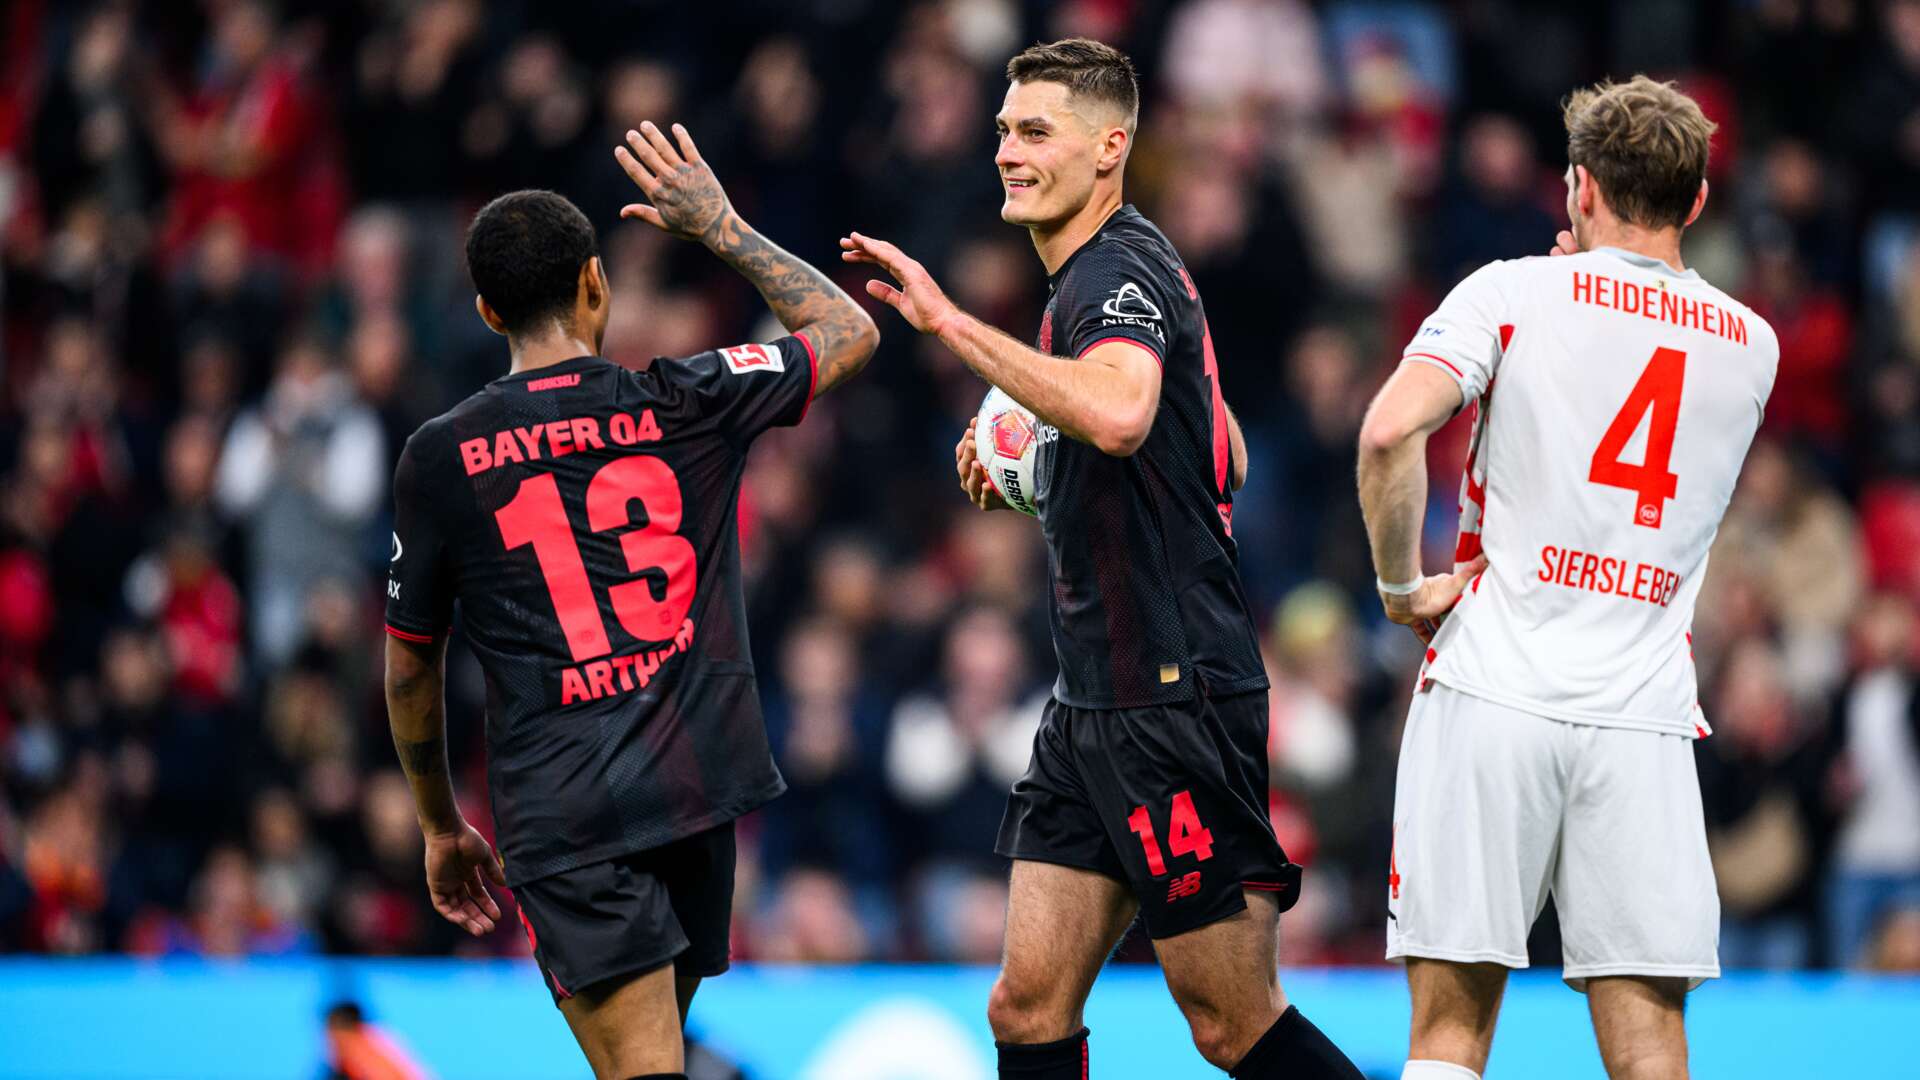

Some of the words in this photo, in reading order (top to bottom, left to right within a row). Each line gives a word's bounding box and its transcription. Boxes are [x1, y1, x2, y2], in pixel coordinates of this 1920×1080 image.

[1572, 271, 1750, 346] HEIDENHEIM
[459, 416, 605, 476] BAYER
[609, 408, 663, 446] 04
[1588, 346, 1687, 530] 4
[494, 454, 697, 663] 13
[1128, 789, 1214, 877] 14
